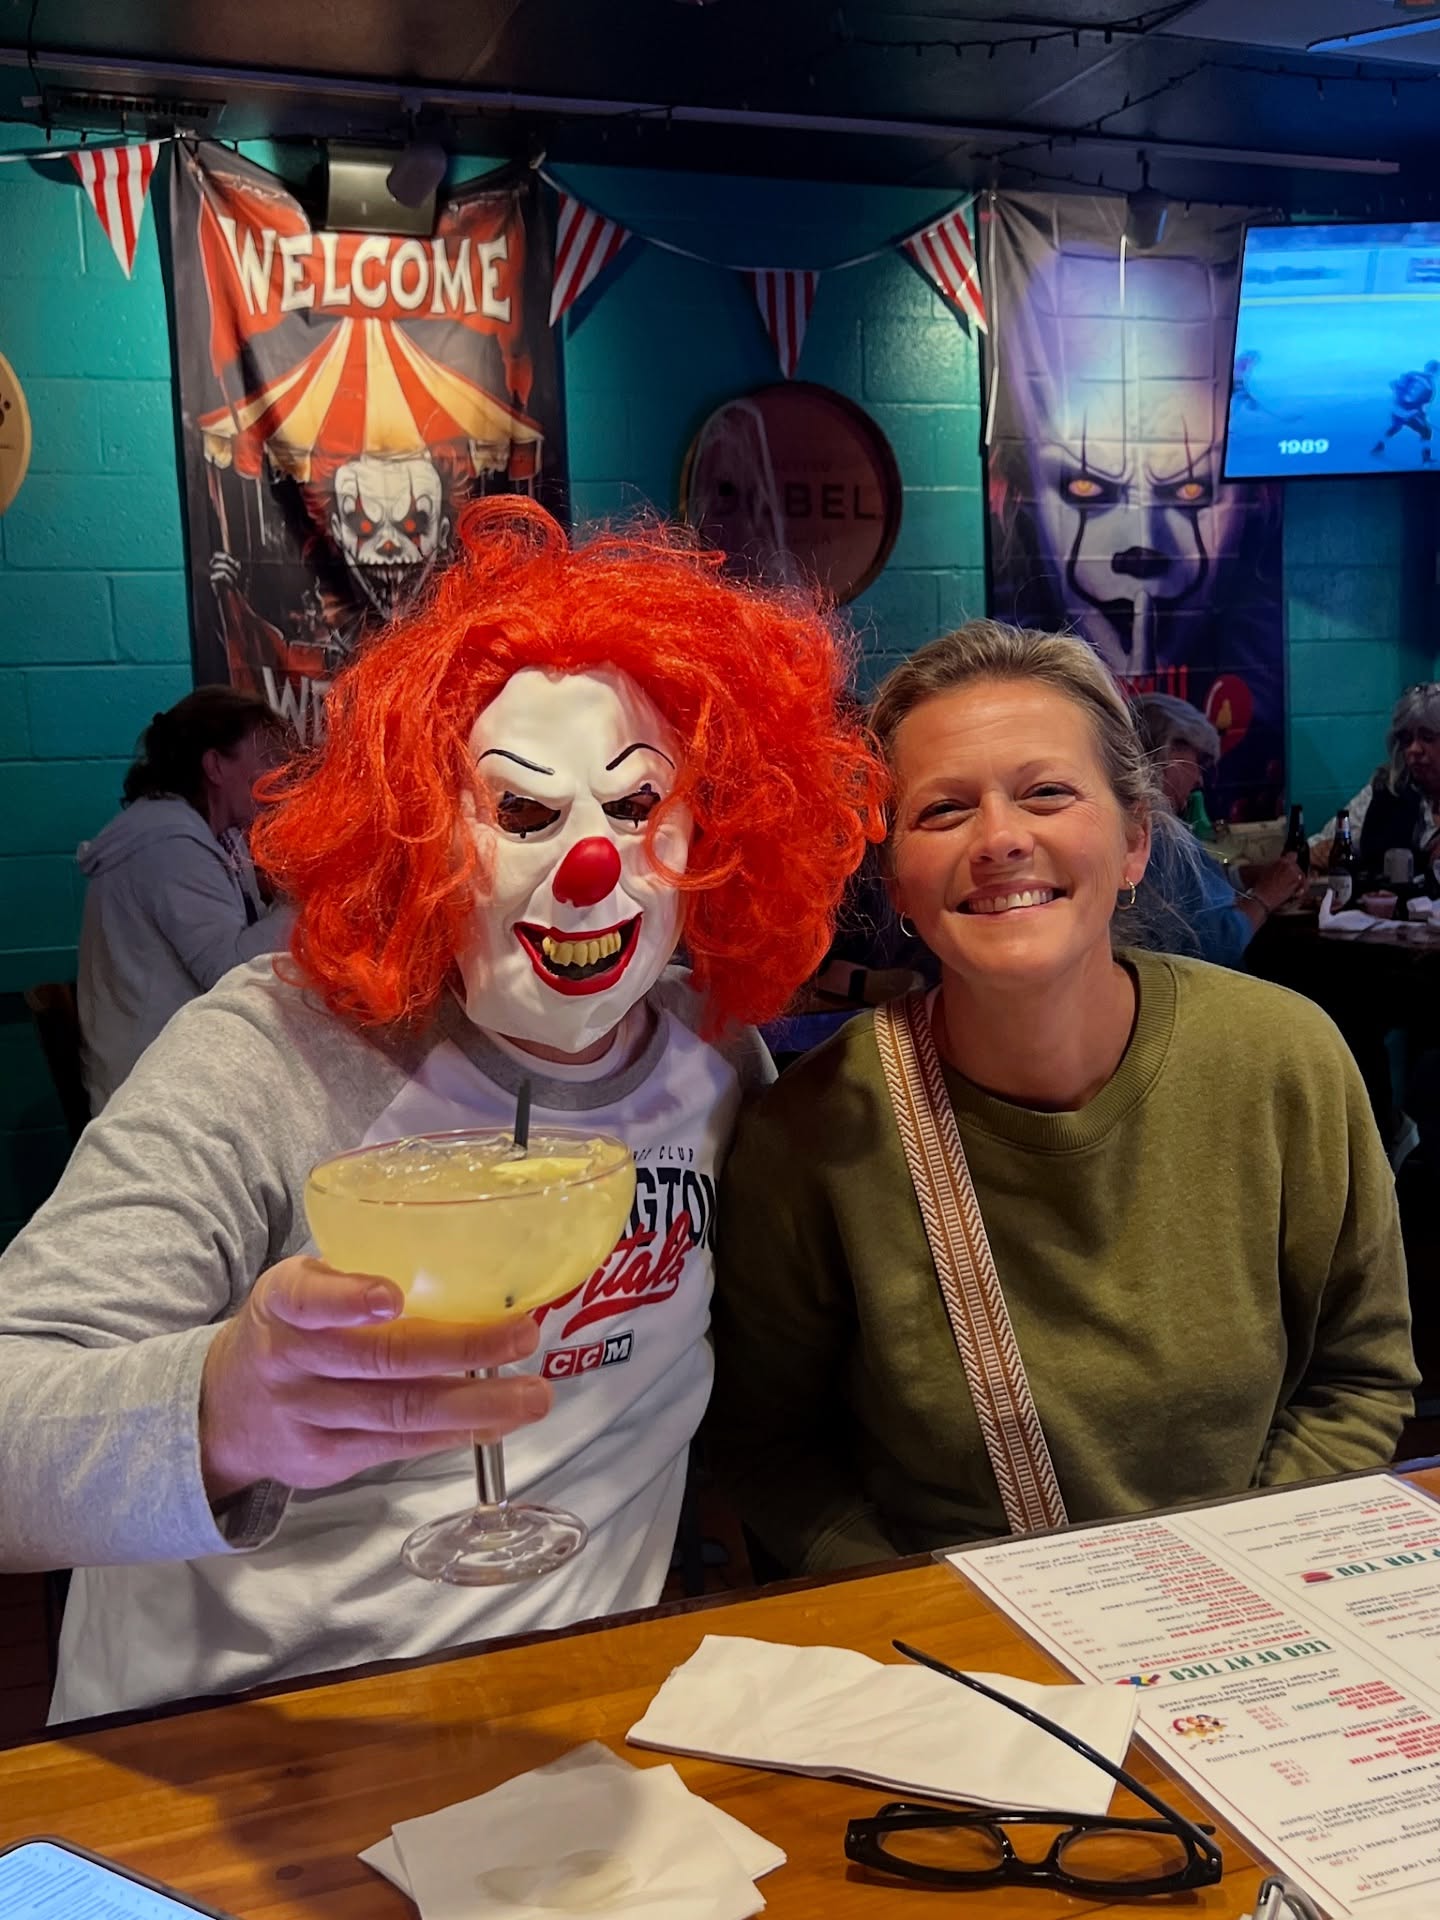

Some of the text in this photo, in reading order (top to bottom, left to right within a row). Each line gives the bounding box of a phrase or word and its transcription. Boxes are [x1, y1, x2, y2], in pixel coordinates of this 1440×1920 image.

[217, 213, 511, 322] WELCOME
[1278, 438, 1329, 455] 1989
[659, 1145, 694, 1163] CLUB
[548, 1336, 632, 1376] CCM
[1336, 1552, 1426, 1576] FOR YOU
[1169, 1640, 1331, 1680] LEGO OF MY TACO
[1238, 1691, 1287, 1705] DRESSINGS
